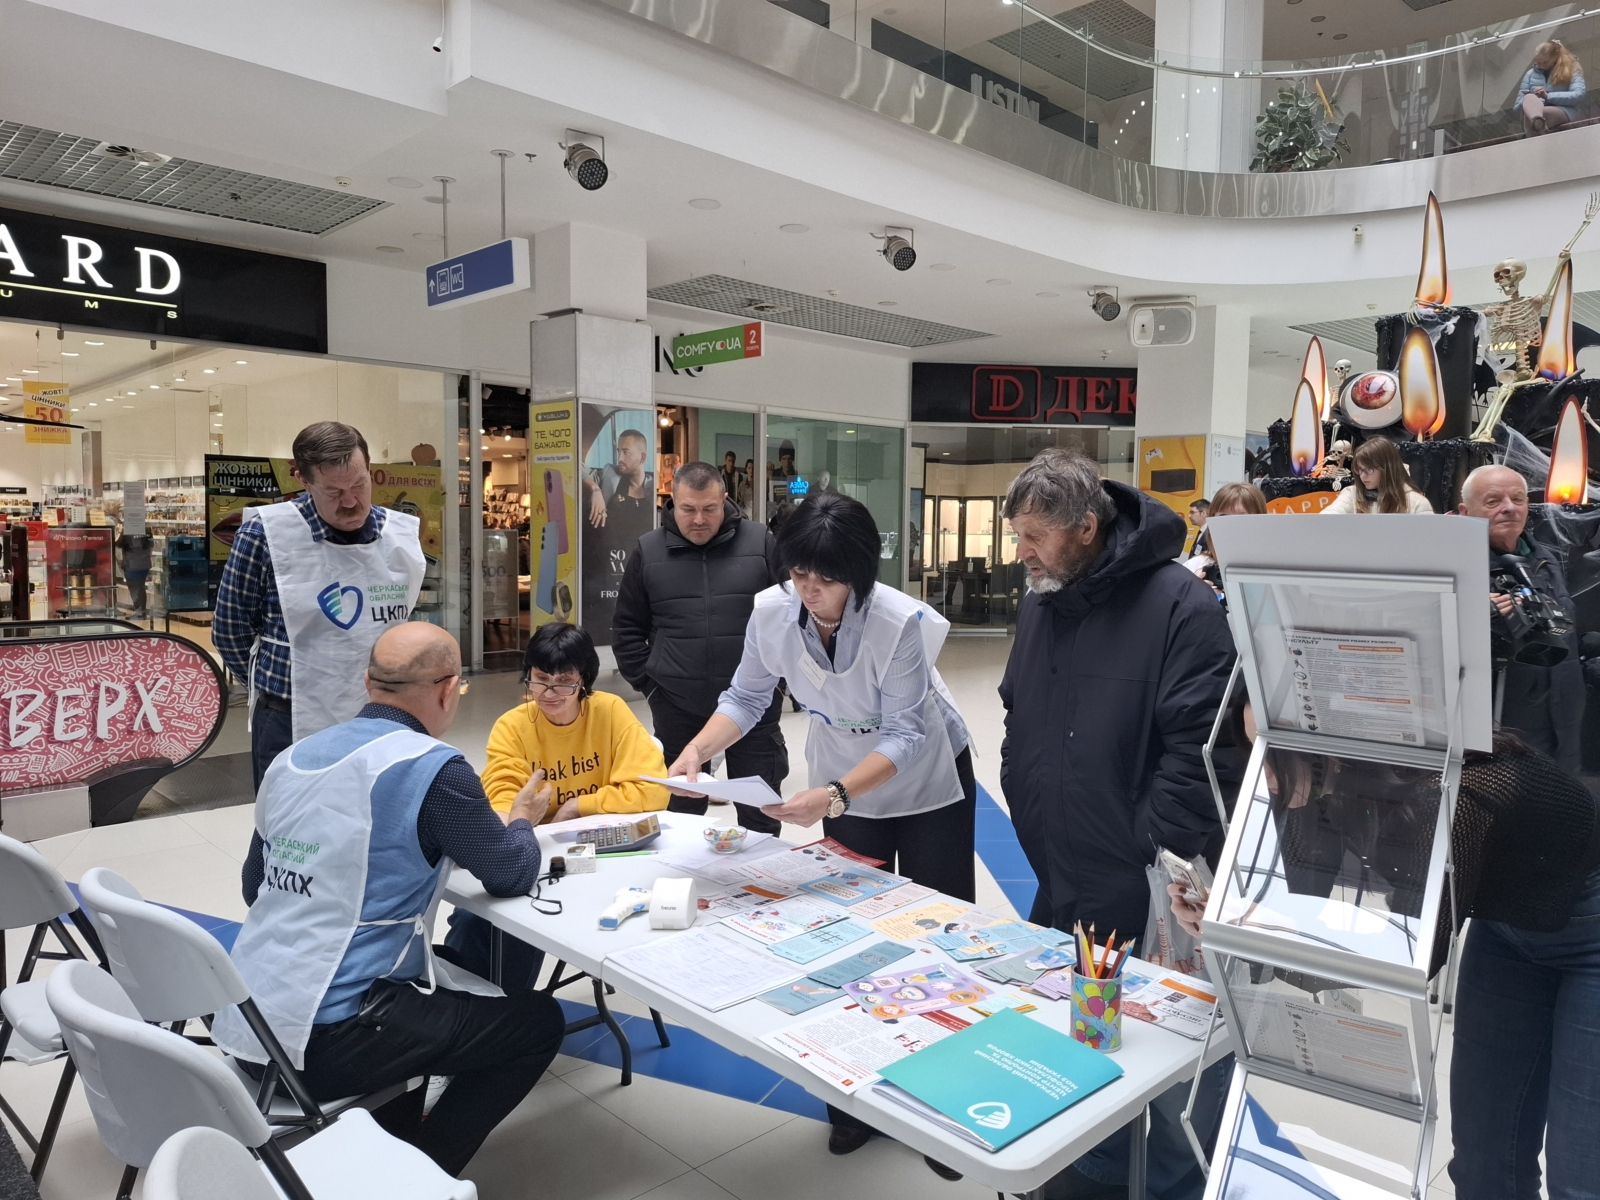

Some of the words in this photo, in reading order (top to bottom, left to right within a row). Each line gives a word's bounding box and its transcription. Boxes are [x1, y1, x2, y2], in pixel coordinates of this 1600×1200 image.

[749, 330, 756, 344] 2
[677, 341, 715, 358] COMFY
[727, 337, 741, 350] UA
[31, 395, 65, 408] ЦІННИКИ
[988, 375, 1024, 411] D
[535, 431, 547, 440] ТЕ,
[549, 428, 571, 438] ЧОГО
[534, 441, 571, 449] БАЖАЮТЬ
[216, 463, 261, 475] ЖОВТІ
[214, 476, 272, 488] ЦІННИКИ
[388, 477, 409, 486] ДЛЯ
[411, 477, 436, 487] ВСІХ!
[1267, 494, 1339, 514] HAPP
[610, 549, 626, 561] SO
[61, 668, 99, 683] BOOKS
[572, 752, 600, 776] bist
[973, 1049, 1013, 1071] ОБЛАСНИЙ
[987, 1043, 1015, 1060] ХВОРОБ
[1001, 1057, 1042, 1080] КОНТРОЛЮ
[1014, 1058, 1073, 1093] ПРОФІЛАКТИКИ
[1029, 1059, 1062, 1079] УКРАЇНИ
[1012, 1070, 1060, 1100] ЧЕРКАСЬКИЙ
[1040, 1079, 1067, 1097] ЦЕНТР
[1061, 1077, 1078, 1090] МОЗ
